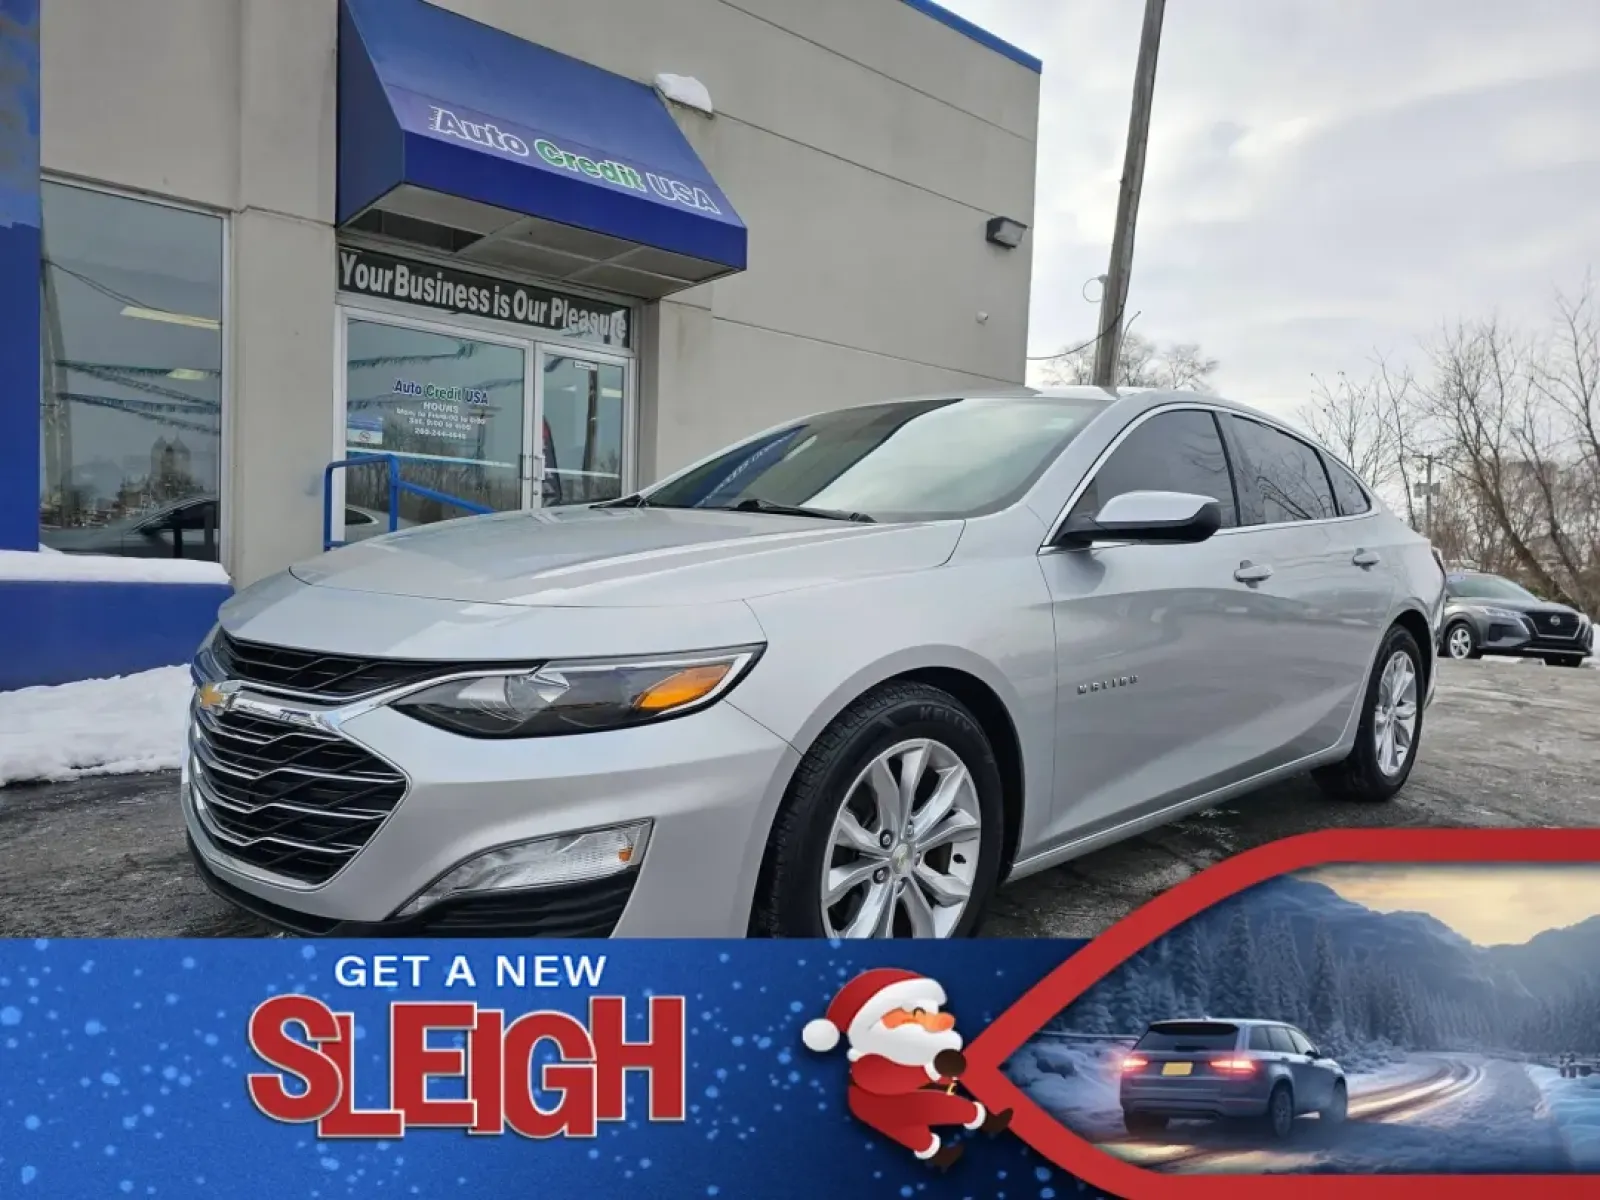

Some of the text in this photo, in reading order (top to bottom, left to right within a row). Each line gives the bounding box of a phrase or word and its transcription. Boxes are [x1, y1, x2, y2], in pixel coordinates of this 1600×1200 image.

[428, 105, 722, 215] Auto Credit USA
[340, 251, 626, 340] Your Business is Our Pleasure
[393, 378, 489, 405] Auto Credit USA
